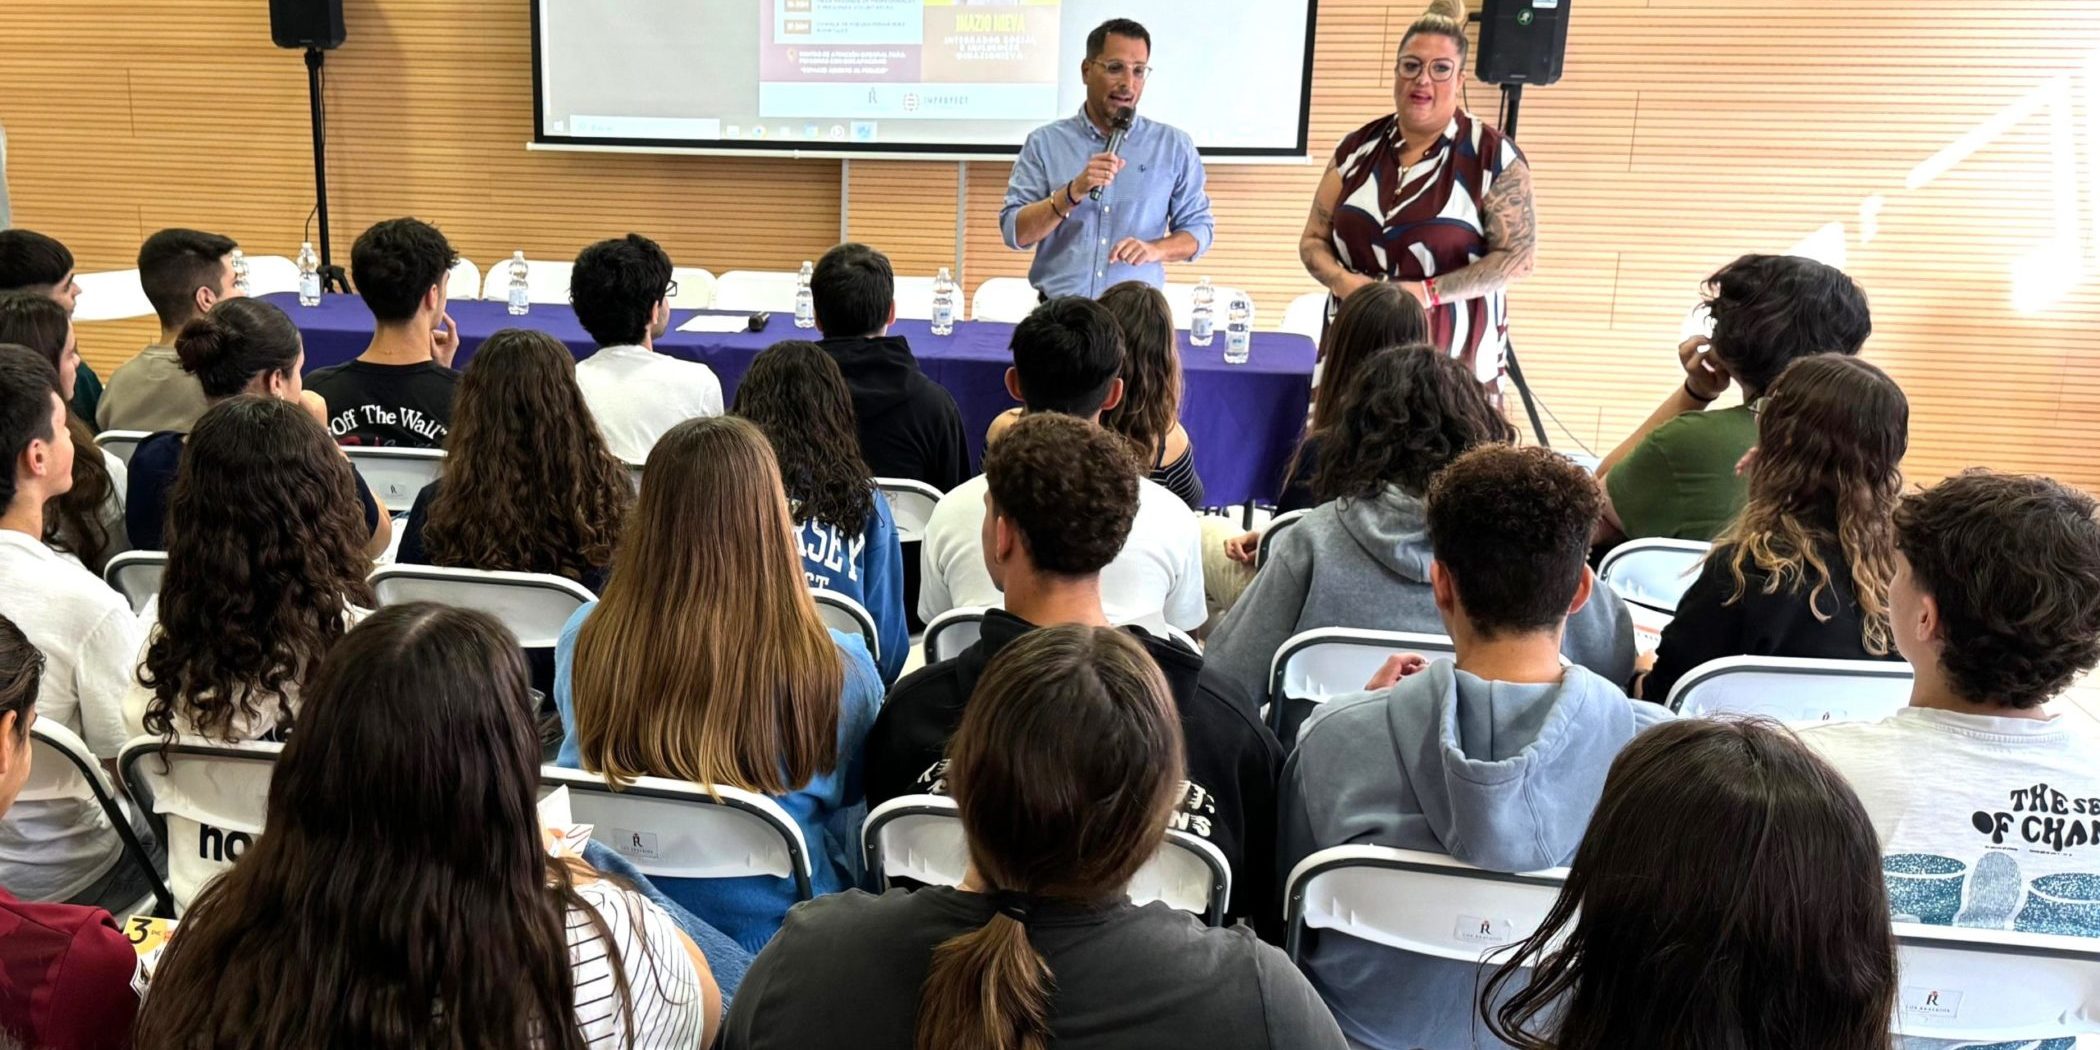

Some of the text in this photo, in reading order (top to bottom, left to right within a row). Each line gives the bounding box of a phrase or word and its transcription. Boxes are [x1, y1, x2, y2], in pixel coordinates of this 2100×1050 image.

[360, 404, 397, 425] The
[2010, 783, 2069, 815] THE
[1972, 811, 2015, 844] OF
[127, 917, 152, 944] 3
